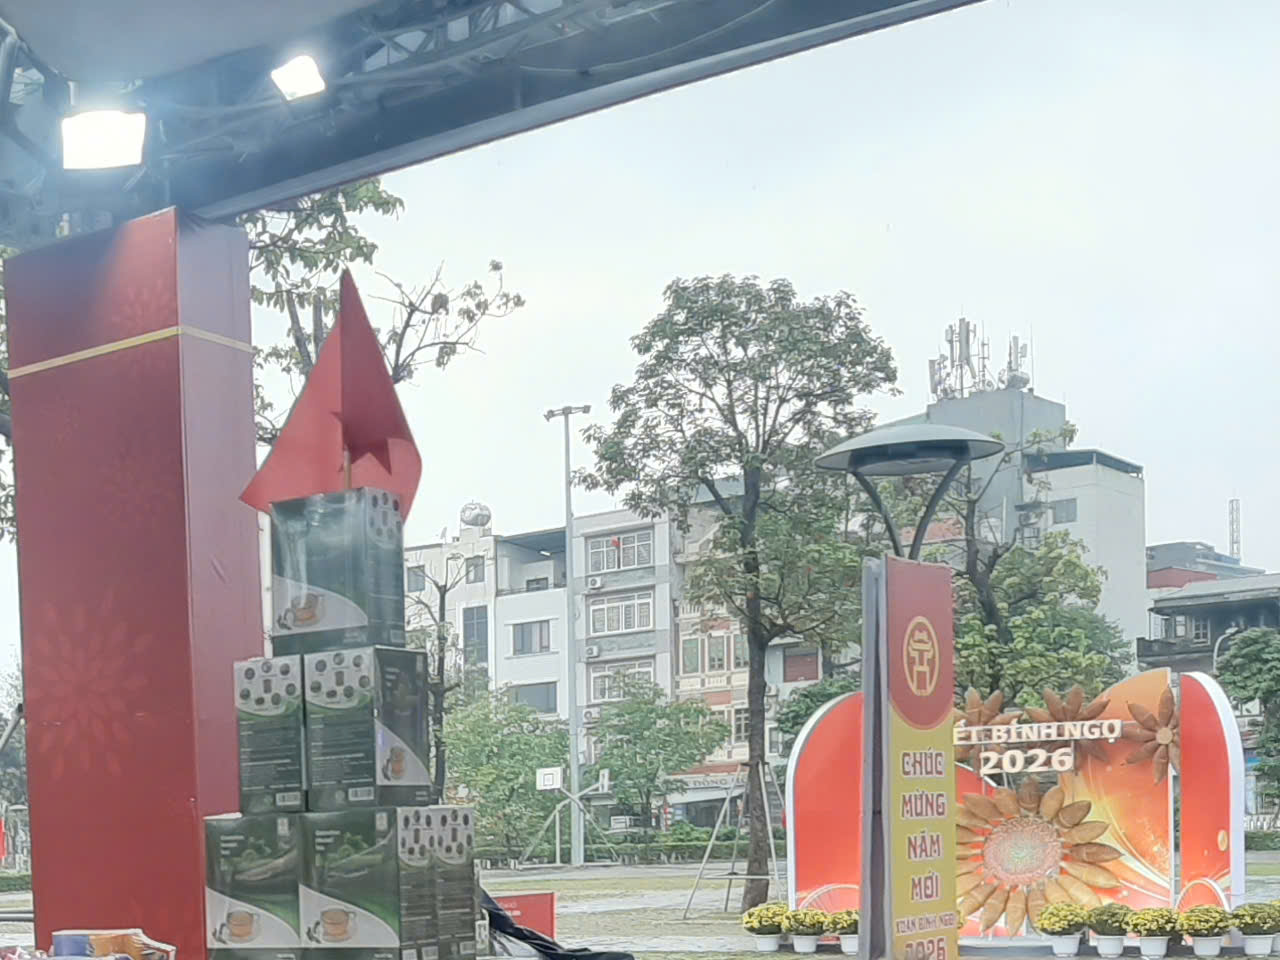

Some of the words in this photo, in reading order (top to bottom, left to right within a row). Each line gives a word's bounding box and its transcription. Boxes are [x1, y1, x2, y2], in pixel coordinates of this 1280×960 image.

[953, 718, 979, 744] ẾT
[991, 718, 1057, 742] BÍNH
[1064, 719, 1122, 744] NGỌ
[901, 747, 944, 776] CHÚC
[979, 747, 1074, 775] 2026
[901, 789, 945, 818] MỪNG
[907, 830, 941, 860] NĂM
[911, 870, 940, 900] MỚI
